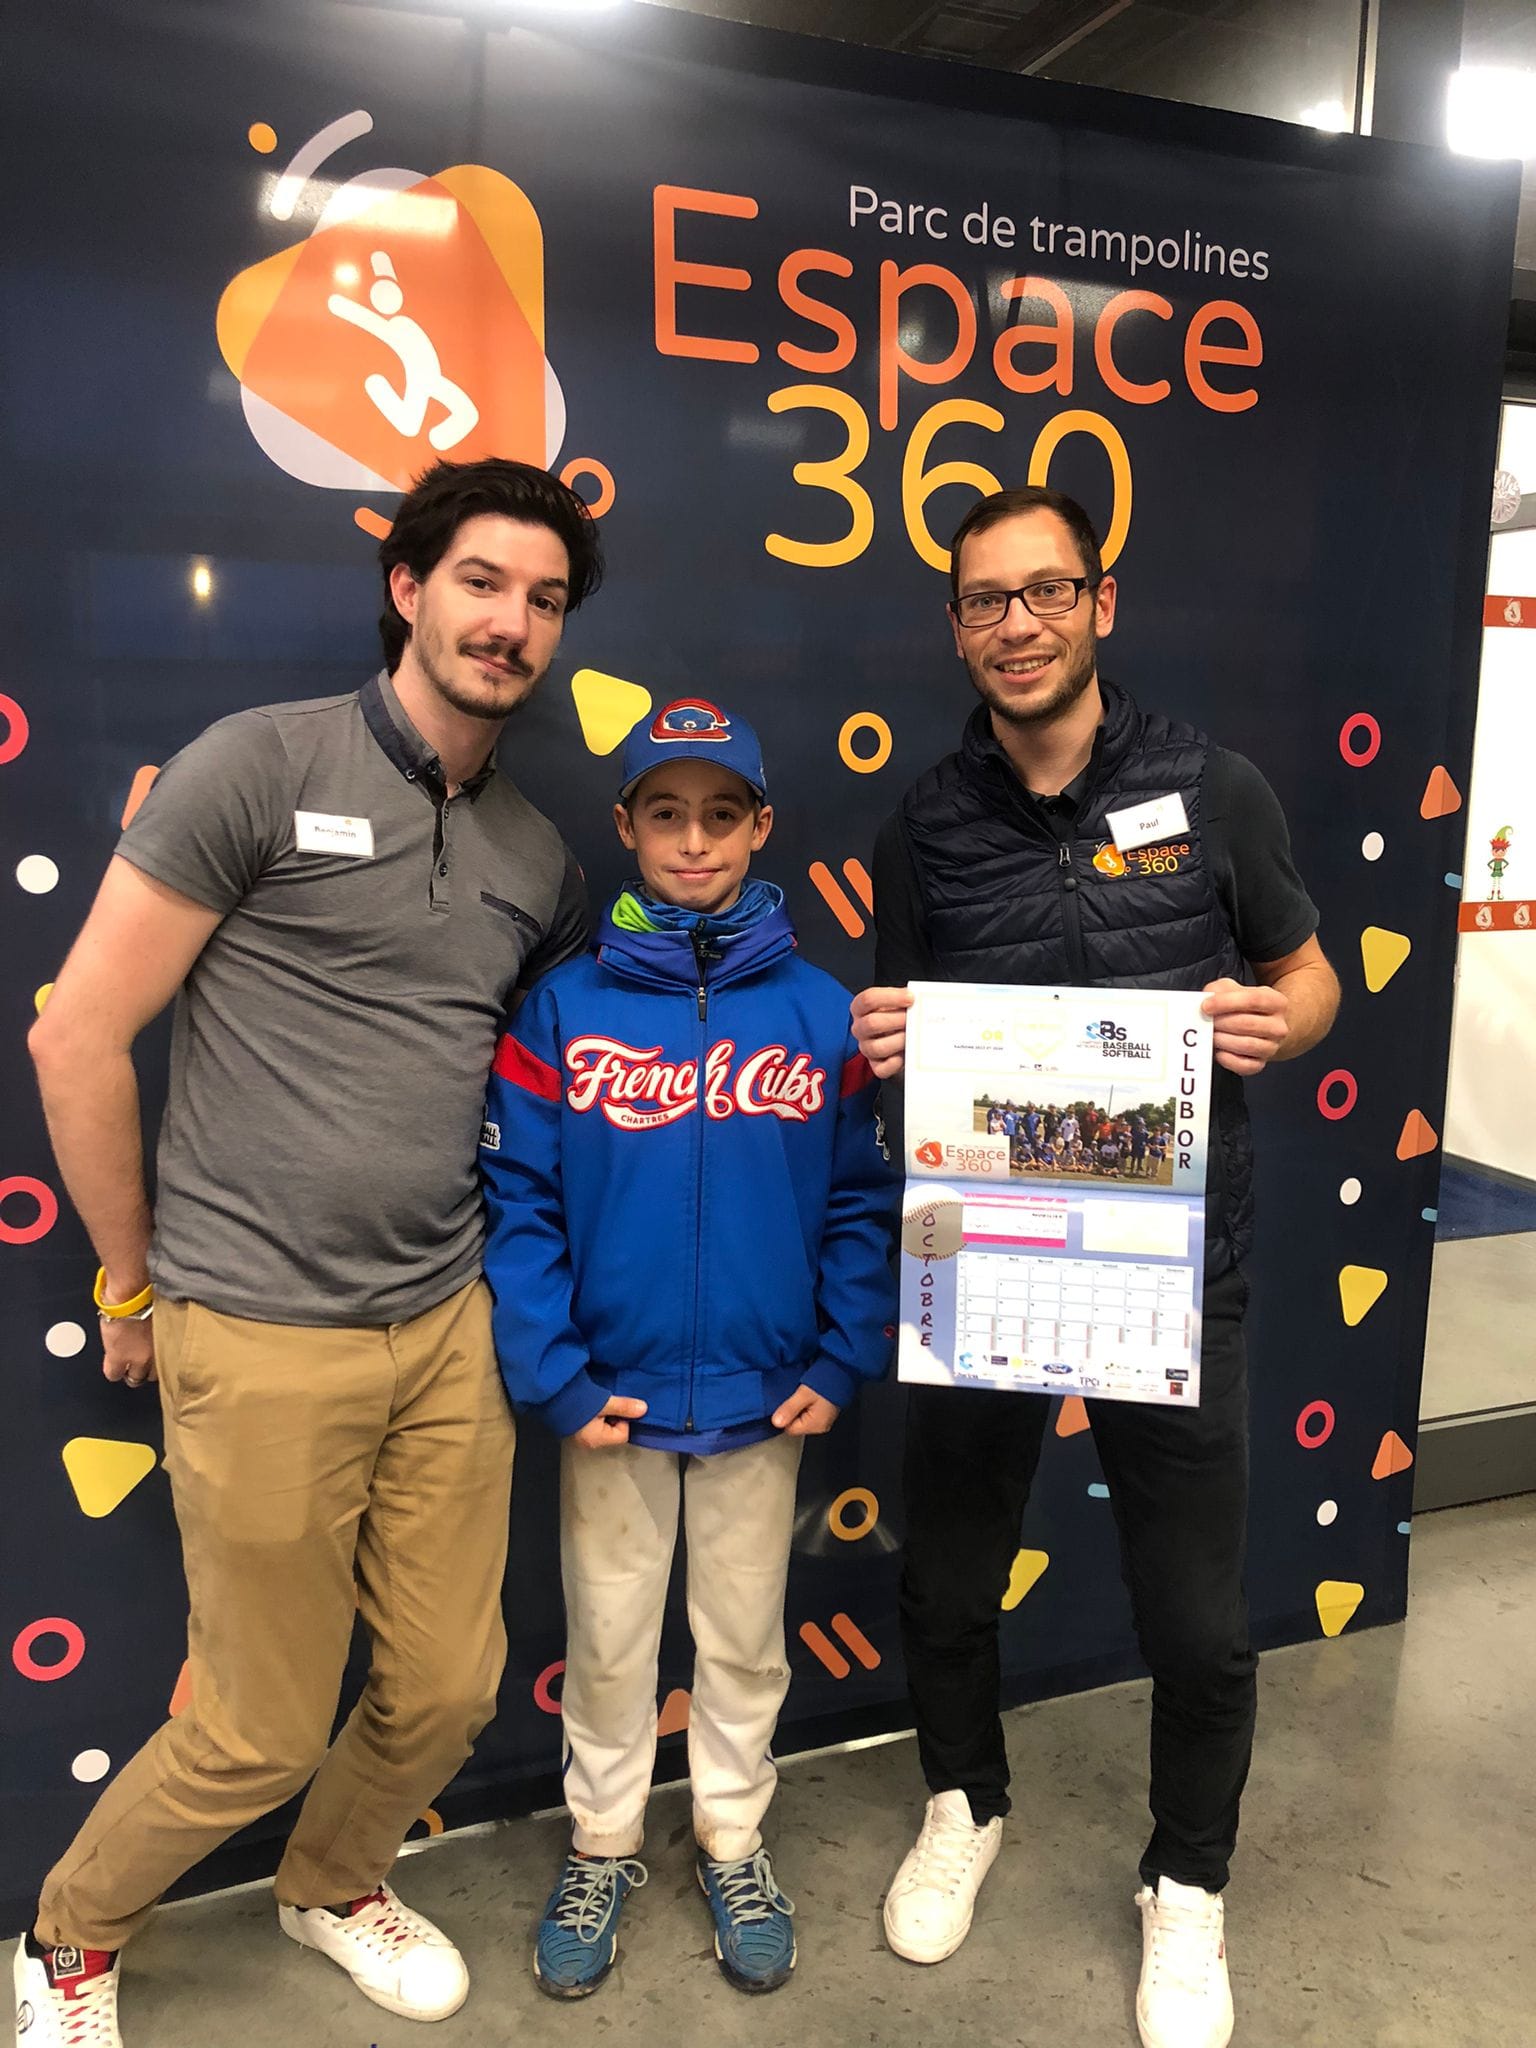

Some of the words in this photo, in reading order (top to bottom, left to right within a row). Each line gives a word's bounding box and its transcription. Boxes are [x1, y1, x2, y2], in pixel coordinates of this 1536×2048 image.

[849, 185, 948, 241] Parc
[962, 202, 1017, 250] de
[1031, 215, 1270, 281] trampolines
[652, 184, 1264, 432] Espace
[765, 384, 1133, 574] 360
[1139, 818, 1159, 830] Paul
[1137, 855, 1179, 875] 360
[1102, 1041, 1152, 1051] BASEBALL
[1102, 1049, 1152, 1059] SOFTBALL
[565, 1034, 736, 1120] French
[733, 1043, 827, 1122] Cubs
[1180, 1028, 1198, 1119] CLUB
[620, 1112, 670, 1126] CHARTRES
[945, 1144, 1007, 1164] Espace
[1177, 1130, 1195, 1170] OR
[955, 1158, 993, 1173] 360
[919, 1212, 937, 1347] OCTOBRE
